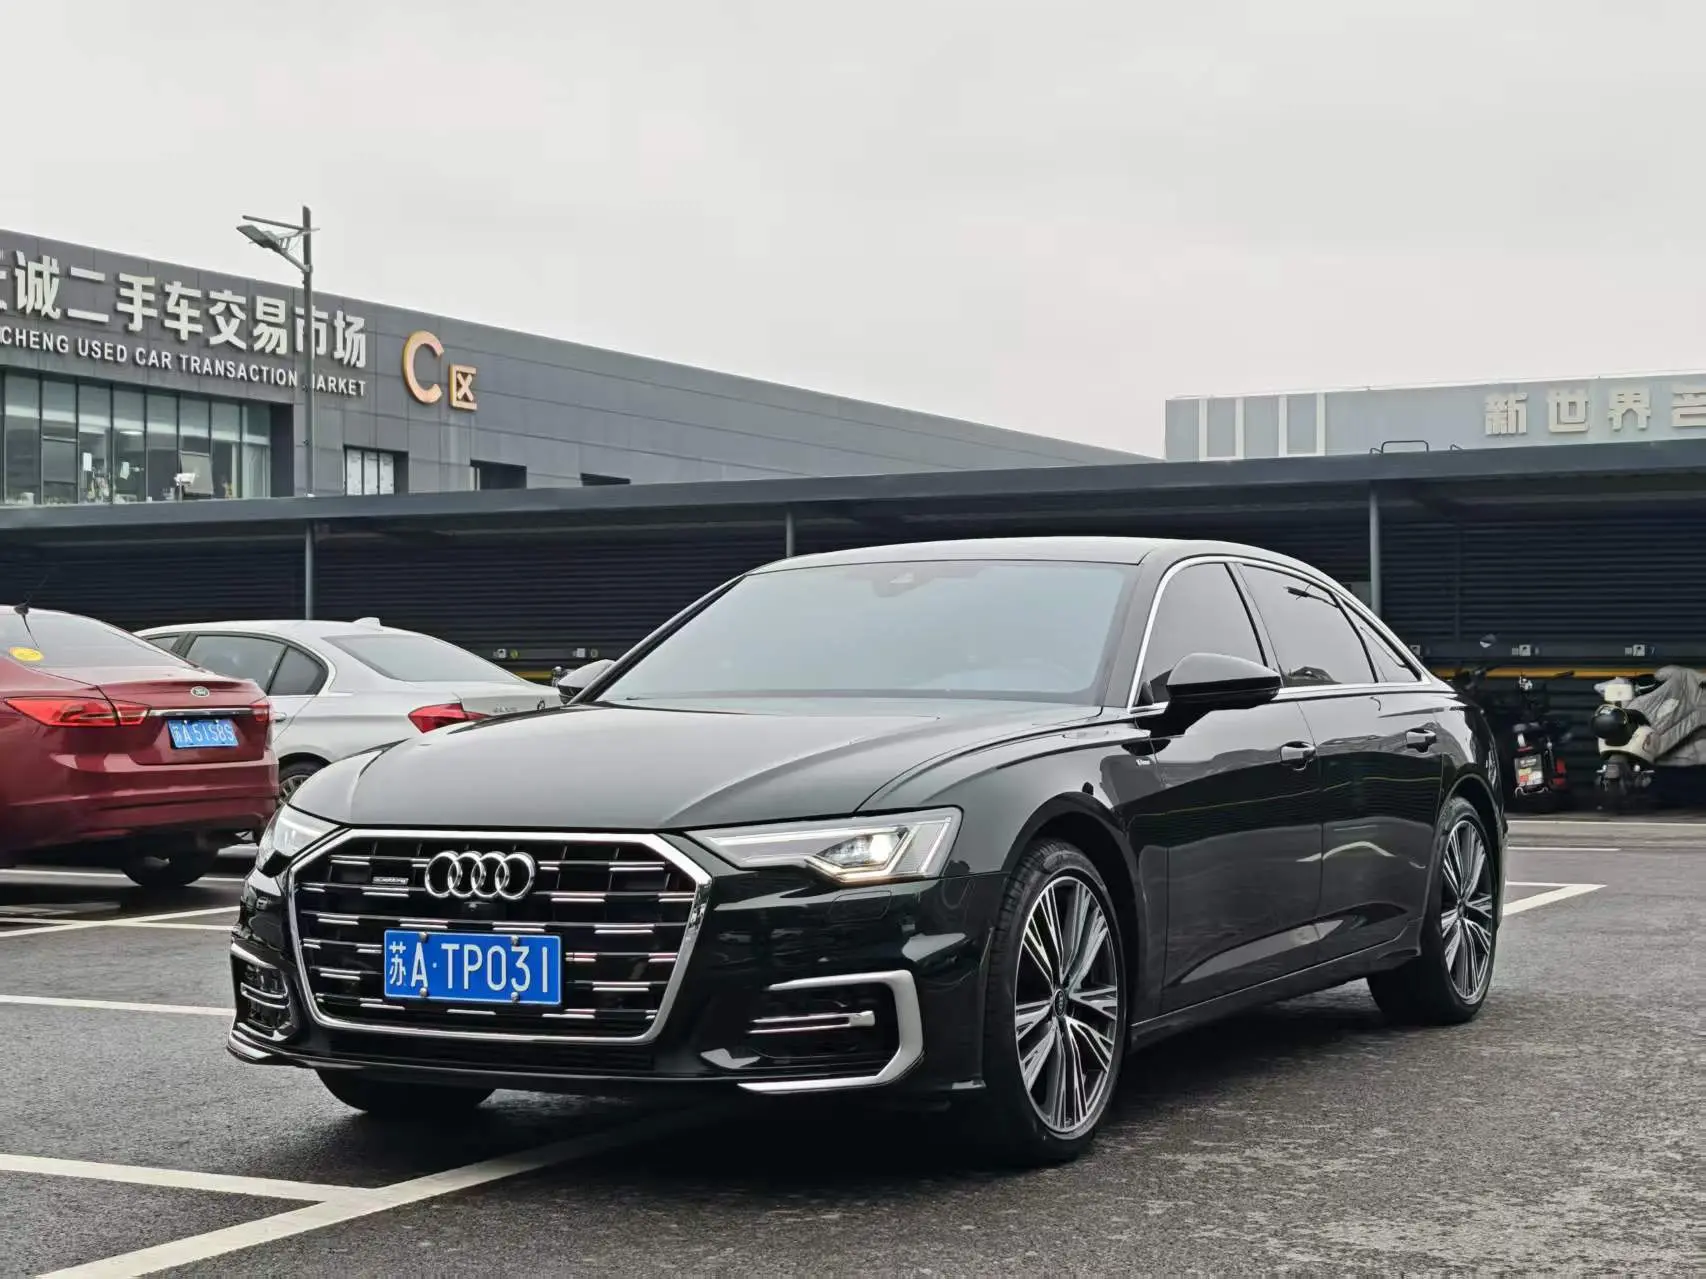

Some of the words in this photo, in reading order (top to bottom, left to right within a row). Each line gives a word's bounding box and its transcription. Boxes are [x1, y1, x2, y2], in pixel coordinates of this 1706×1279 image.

[0, 248, 366, 368] 诚二手车交易市场
[0, 325, 69, 353] CHENG
[78, 336, 127, 362] USED
[135, 347, 172, 369] CAR
[180, 354, 298, 387] TRANSACTION
[311, 373, 366, 396] ARKET
